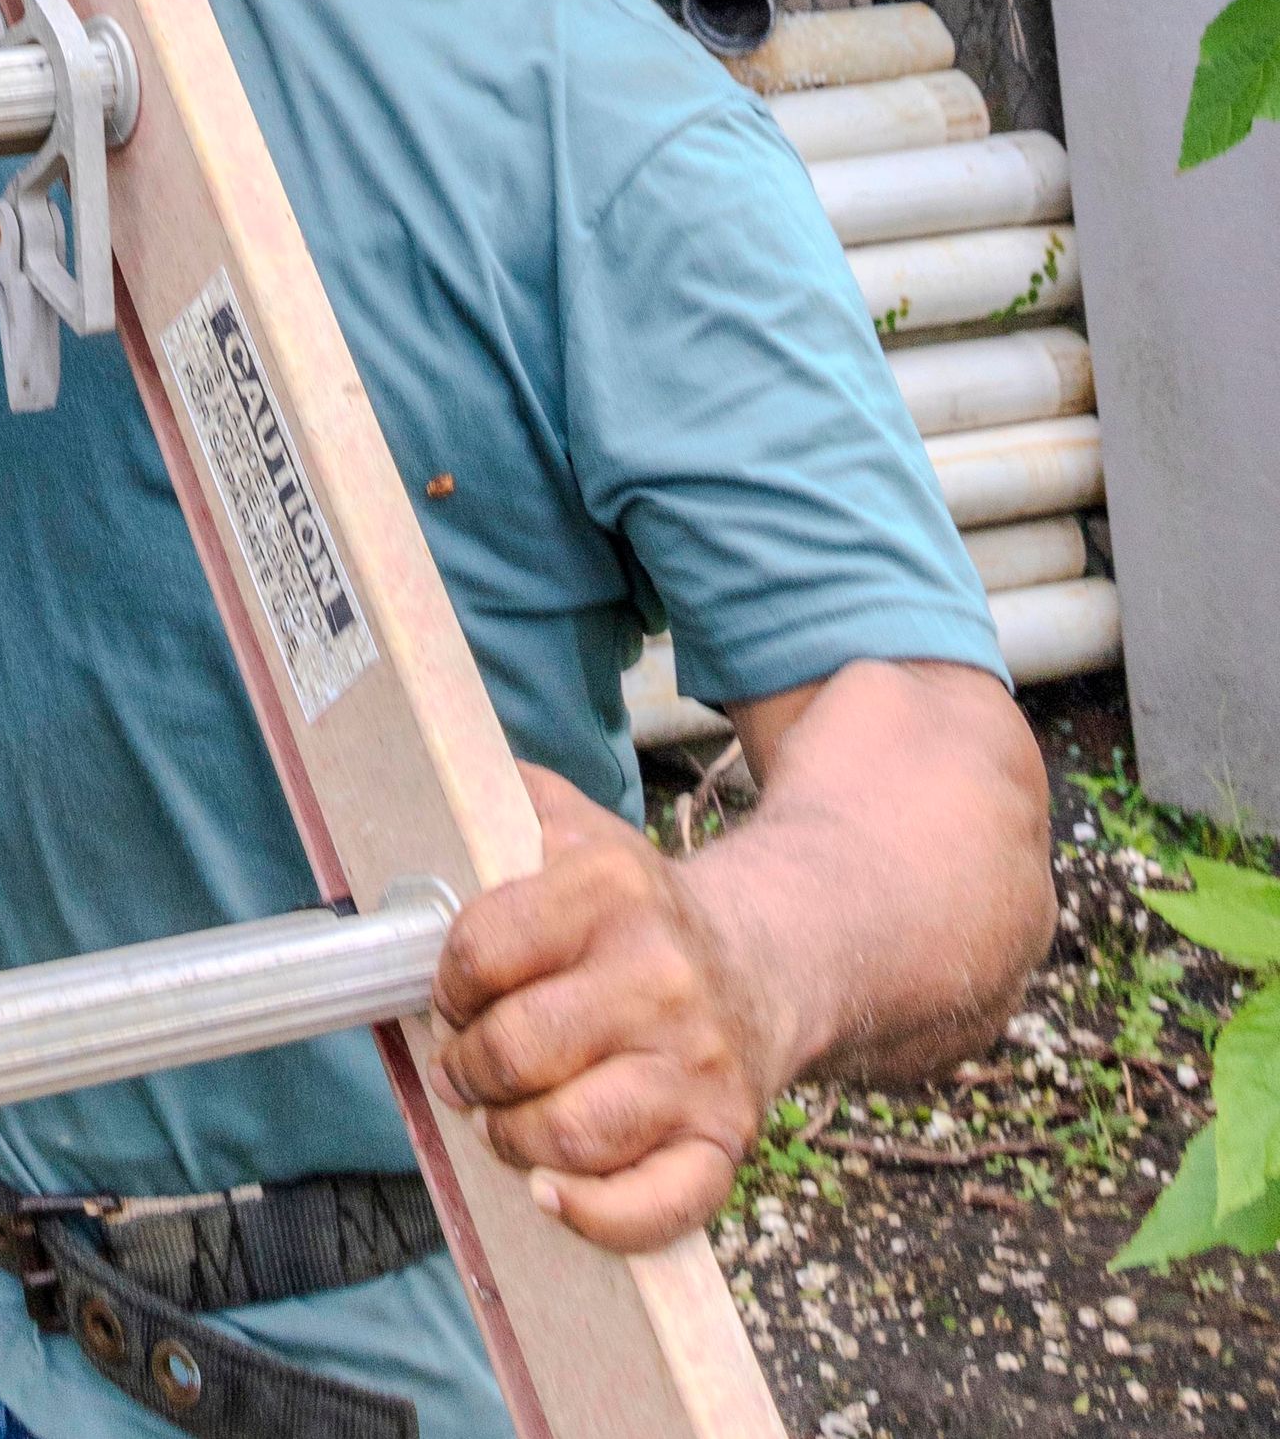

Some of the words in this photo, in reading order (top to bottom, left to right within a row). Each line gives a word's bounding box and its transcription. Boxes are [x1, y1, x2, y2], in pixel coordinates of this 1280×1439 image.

[181, 361, 211, 426] FOR
[207, 430, 274, 588] SEPARATE
[269, 589, 301, 657] USE
[193, 316, 227, 389] THIS
[222, 389, 277, 514] LADDER
[197, 364, 216, 399] IS
[211, 400, 242, 466] NOT
[238, 469, 307, 630] DESIGNED
[223, 327, 341, 607] CAUTION
